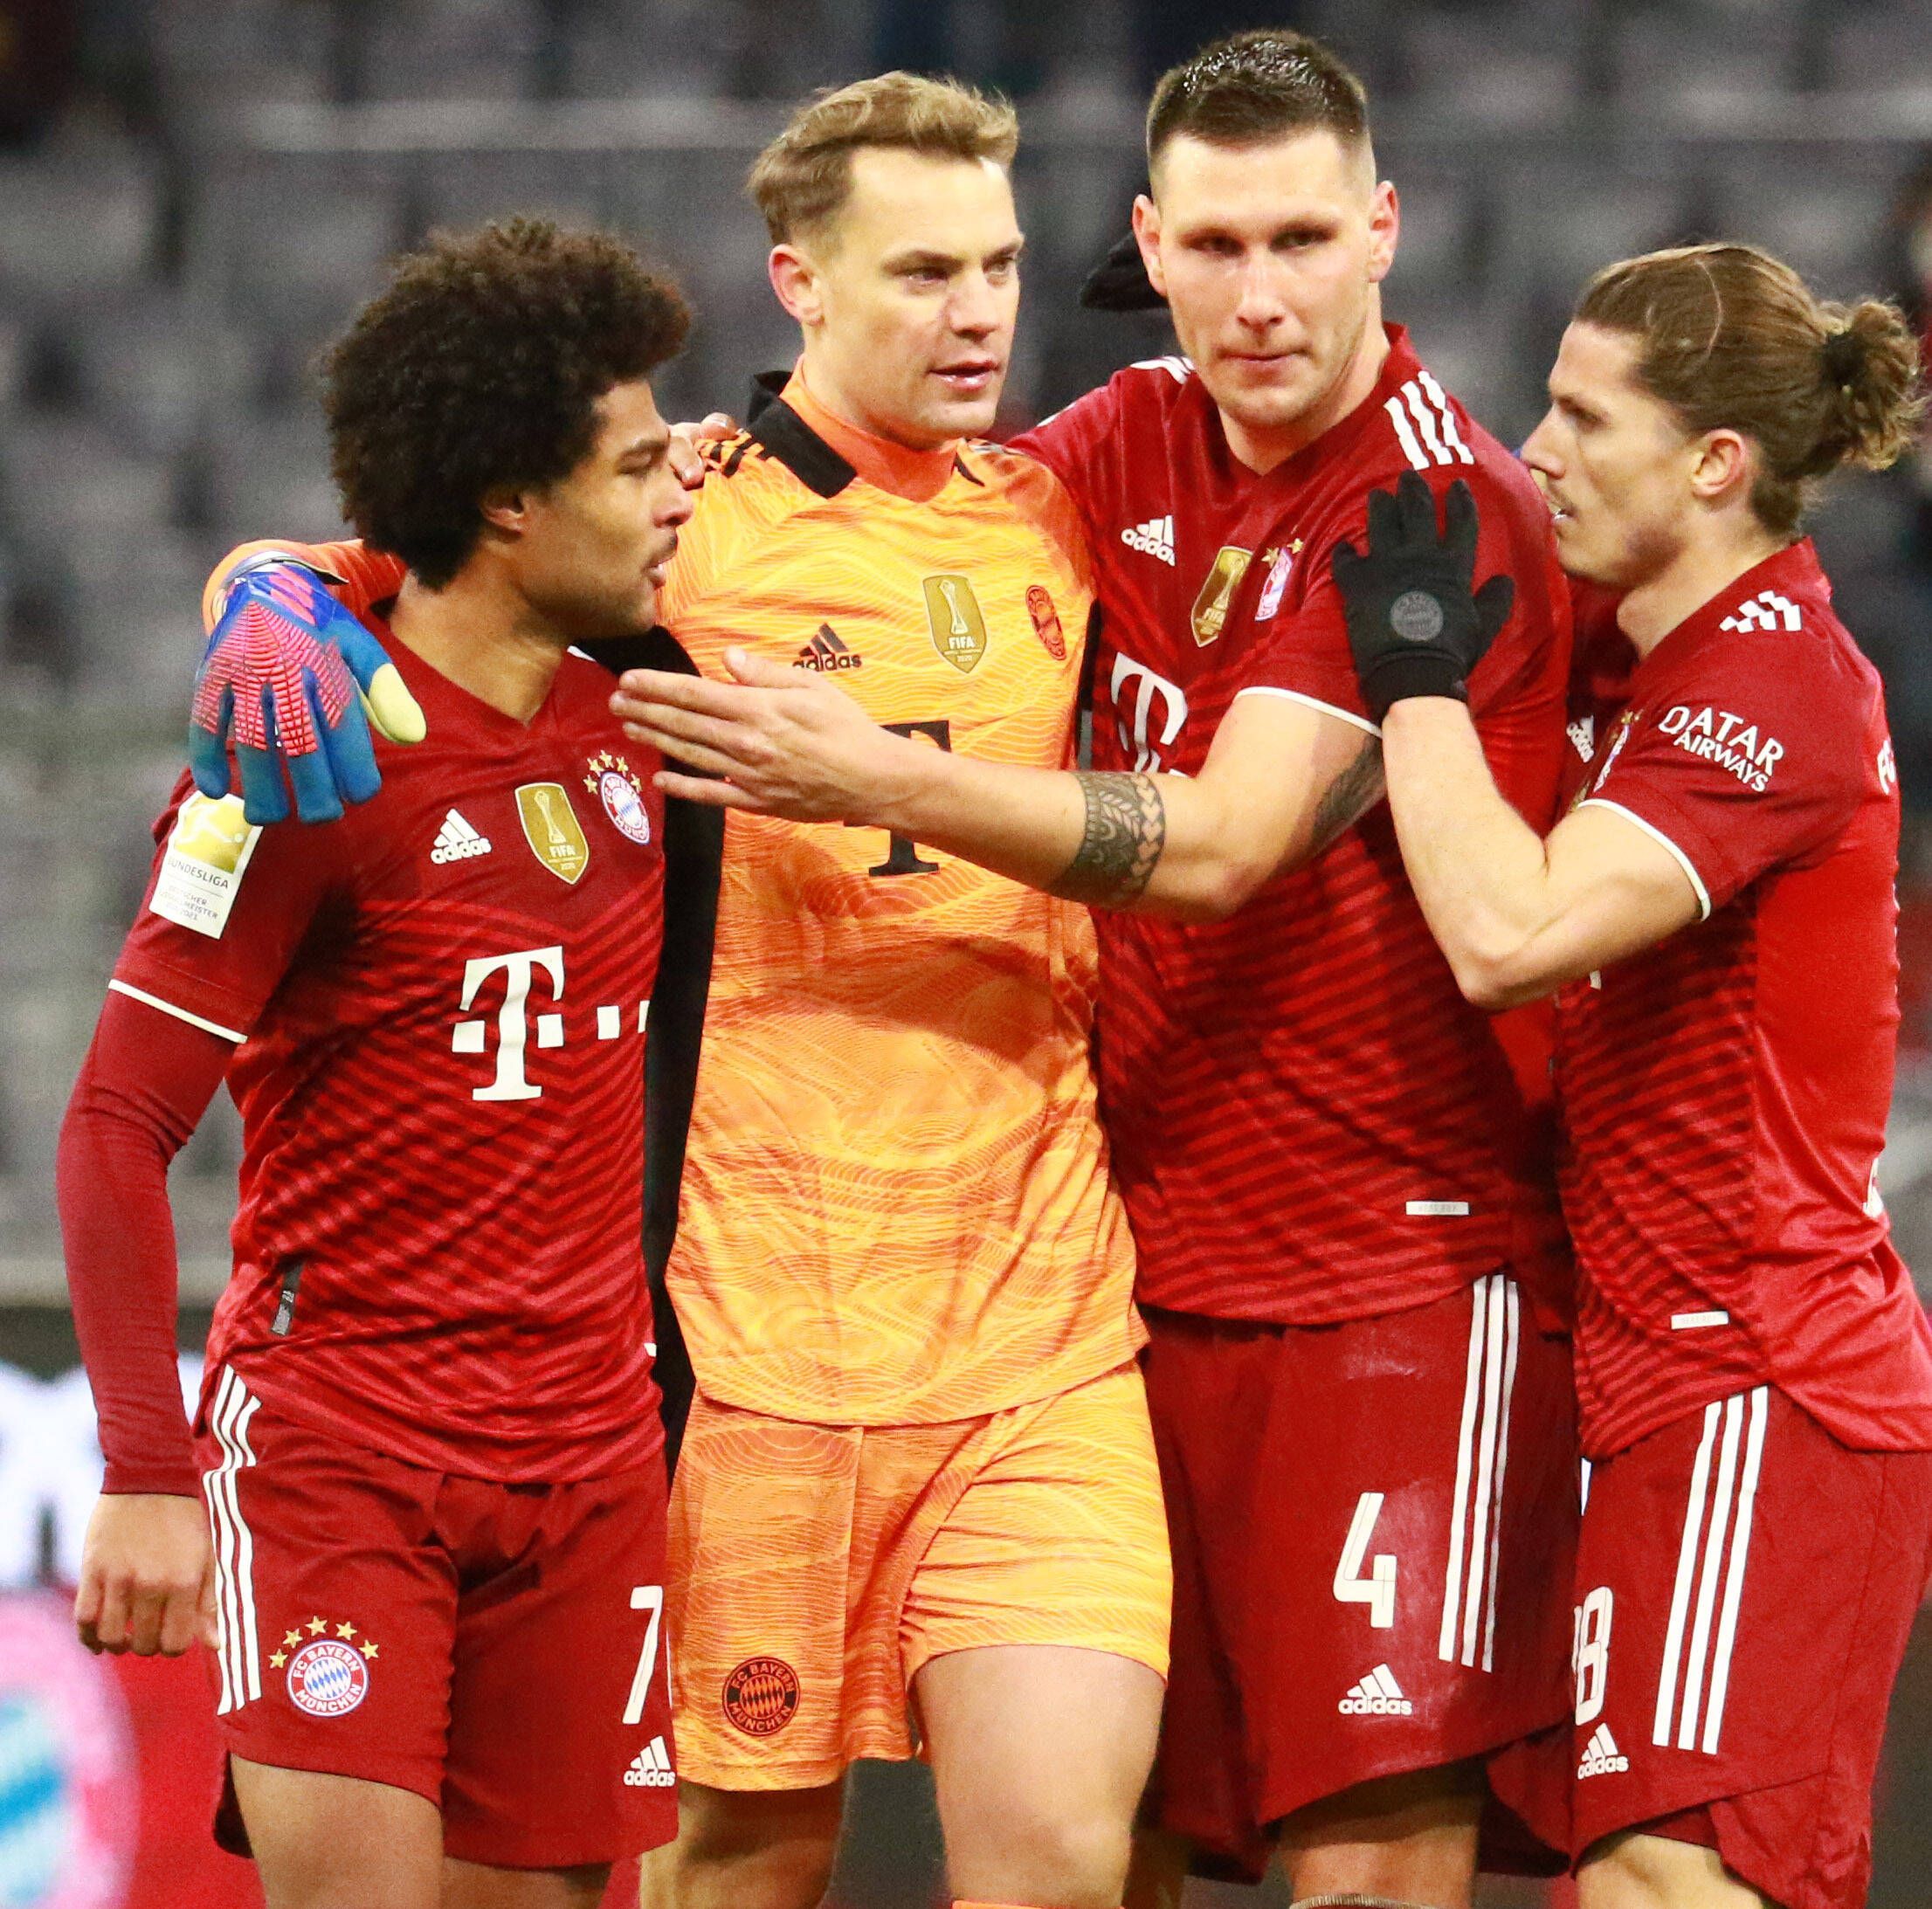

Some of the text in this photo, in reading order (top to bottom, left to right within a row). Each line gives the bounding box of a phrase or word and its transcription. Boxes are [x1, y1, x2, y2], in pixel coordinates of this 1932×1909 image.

[1121, 528, 1176, 567] adidas
[949, 636, 976, 650] FIFA
[792, 654, 862, 672] adidas
[1659, 706, 1784, 776] QATAR
[1673, 730, 1769, 793] AIRWAYS
[431, 837, 492, 865] adidas
[549, 844, 576, 858] FIFA
[1333, 1492, 1397, 1629] 4
[293, 1645, 361, 1678] FC BAYERN
[623, 1585, 663, 1725] 7
[732, 1663, 796, 1692] FC BAYERN
[1338, 1696, 1412, 1716] adidas
[624, 1766, 675, 1787] adidas
[1577, 1755, 1629, 1780] adidas
